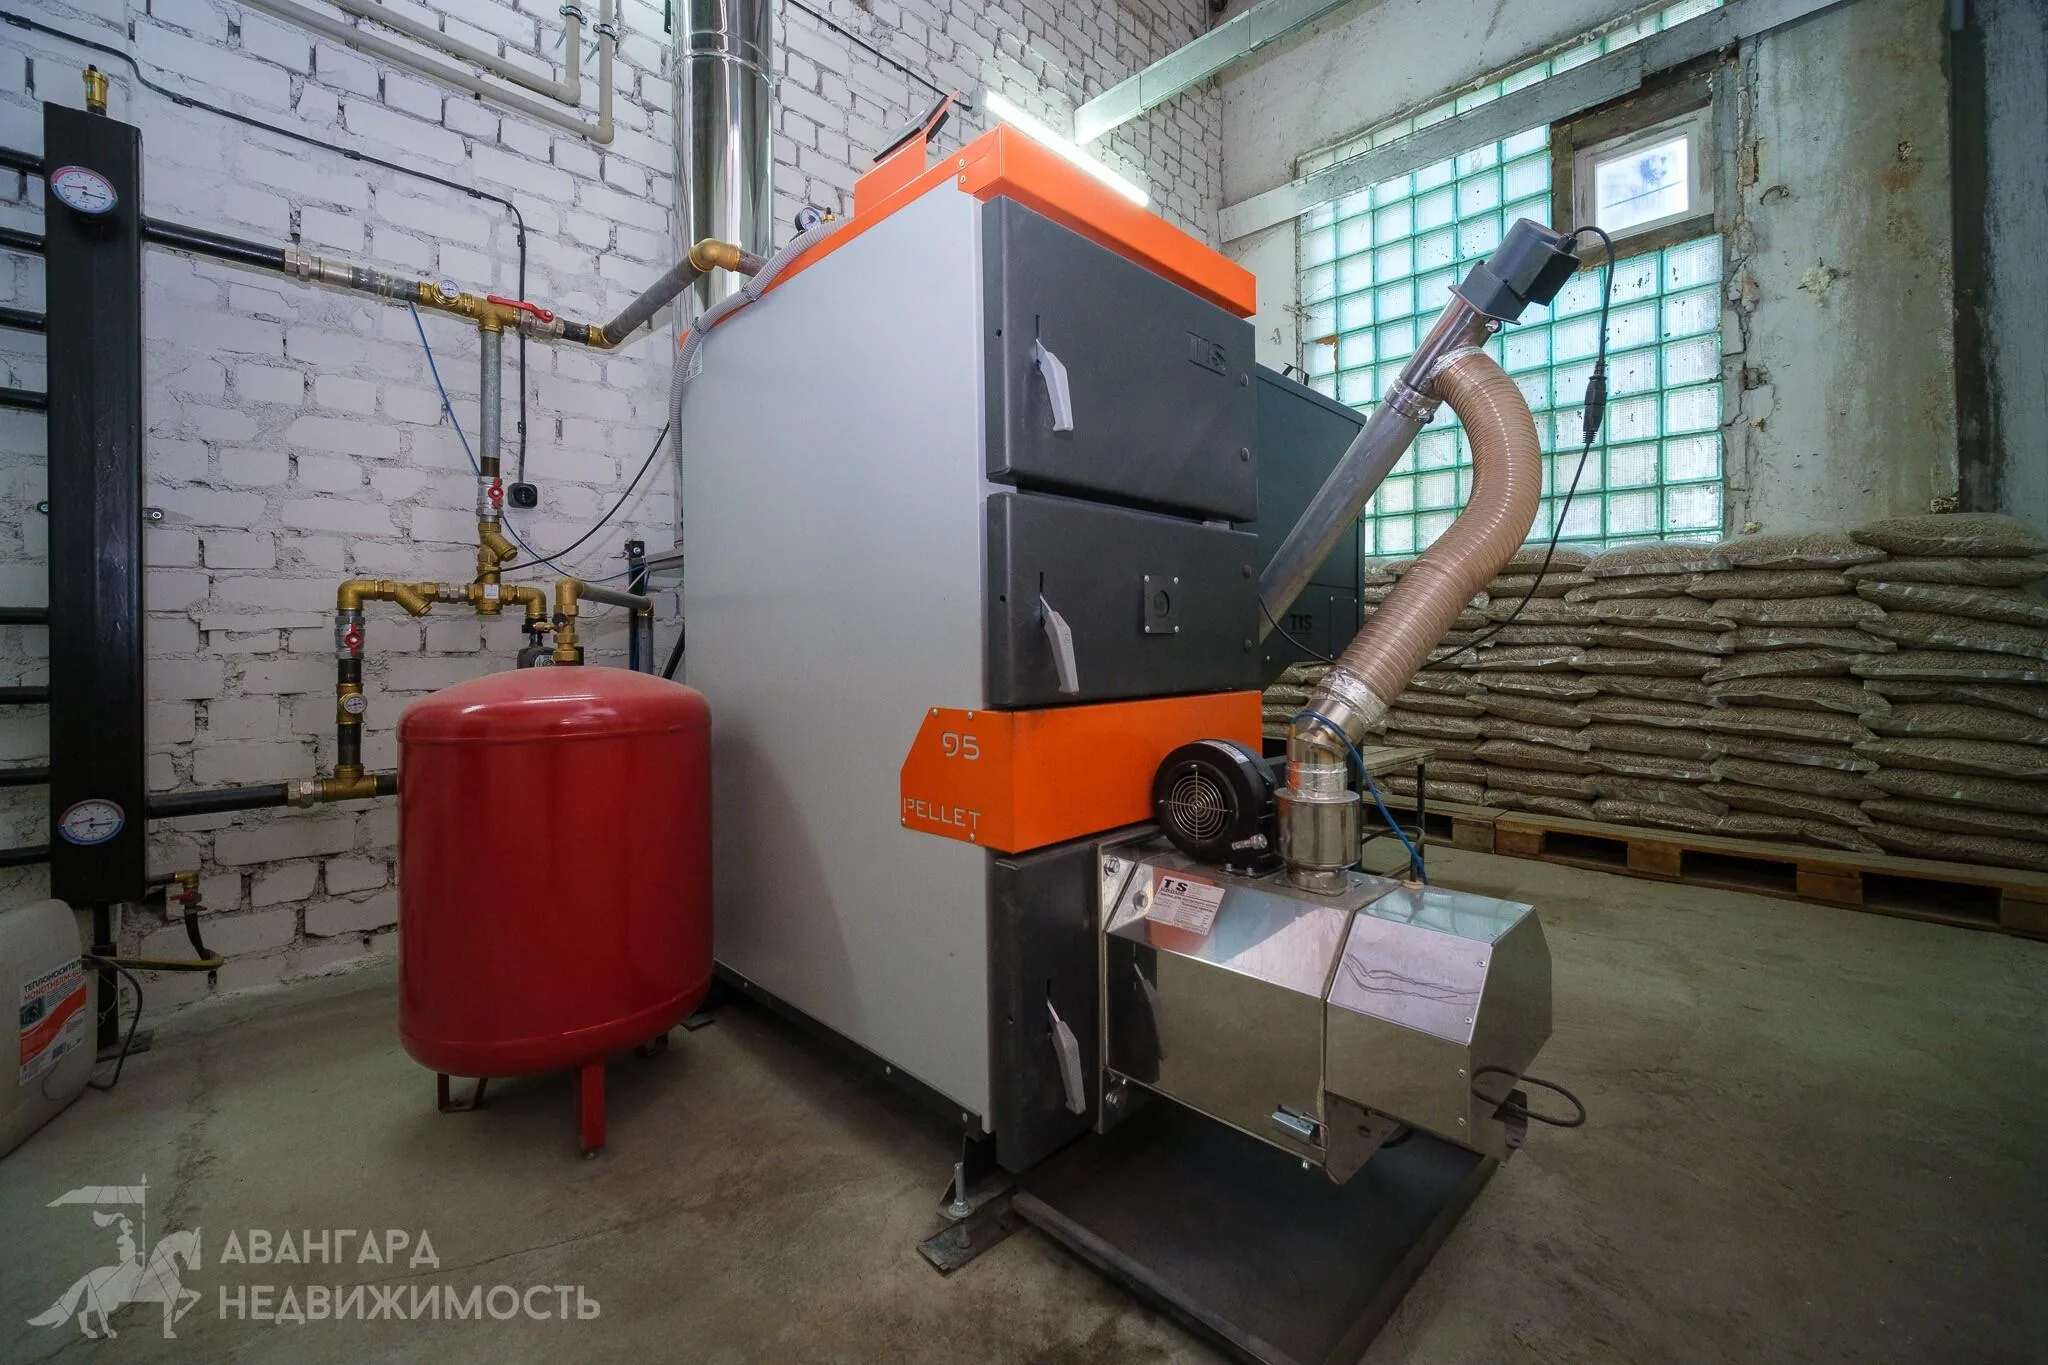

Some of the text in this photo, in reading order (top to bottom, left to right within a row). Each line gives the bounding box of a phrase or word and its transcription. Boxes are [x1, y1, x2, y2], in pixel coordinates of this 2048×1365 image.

[1290, 614, 1313, 632] TIS
[942, 732, 980, 760] 95
[903, 797, 981, 830] PELLET
[24, 959, 83, 993] ТЕПЛОНОСИТЕЛ
